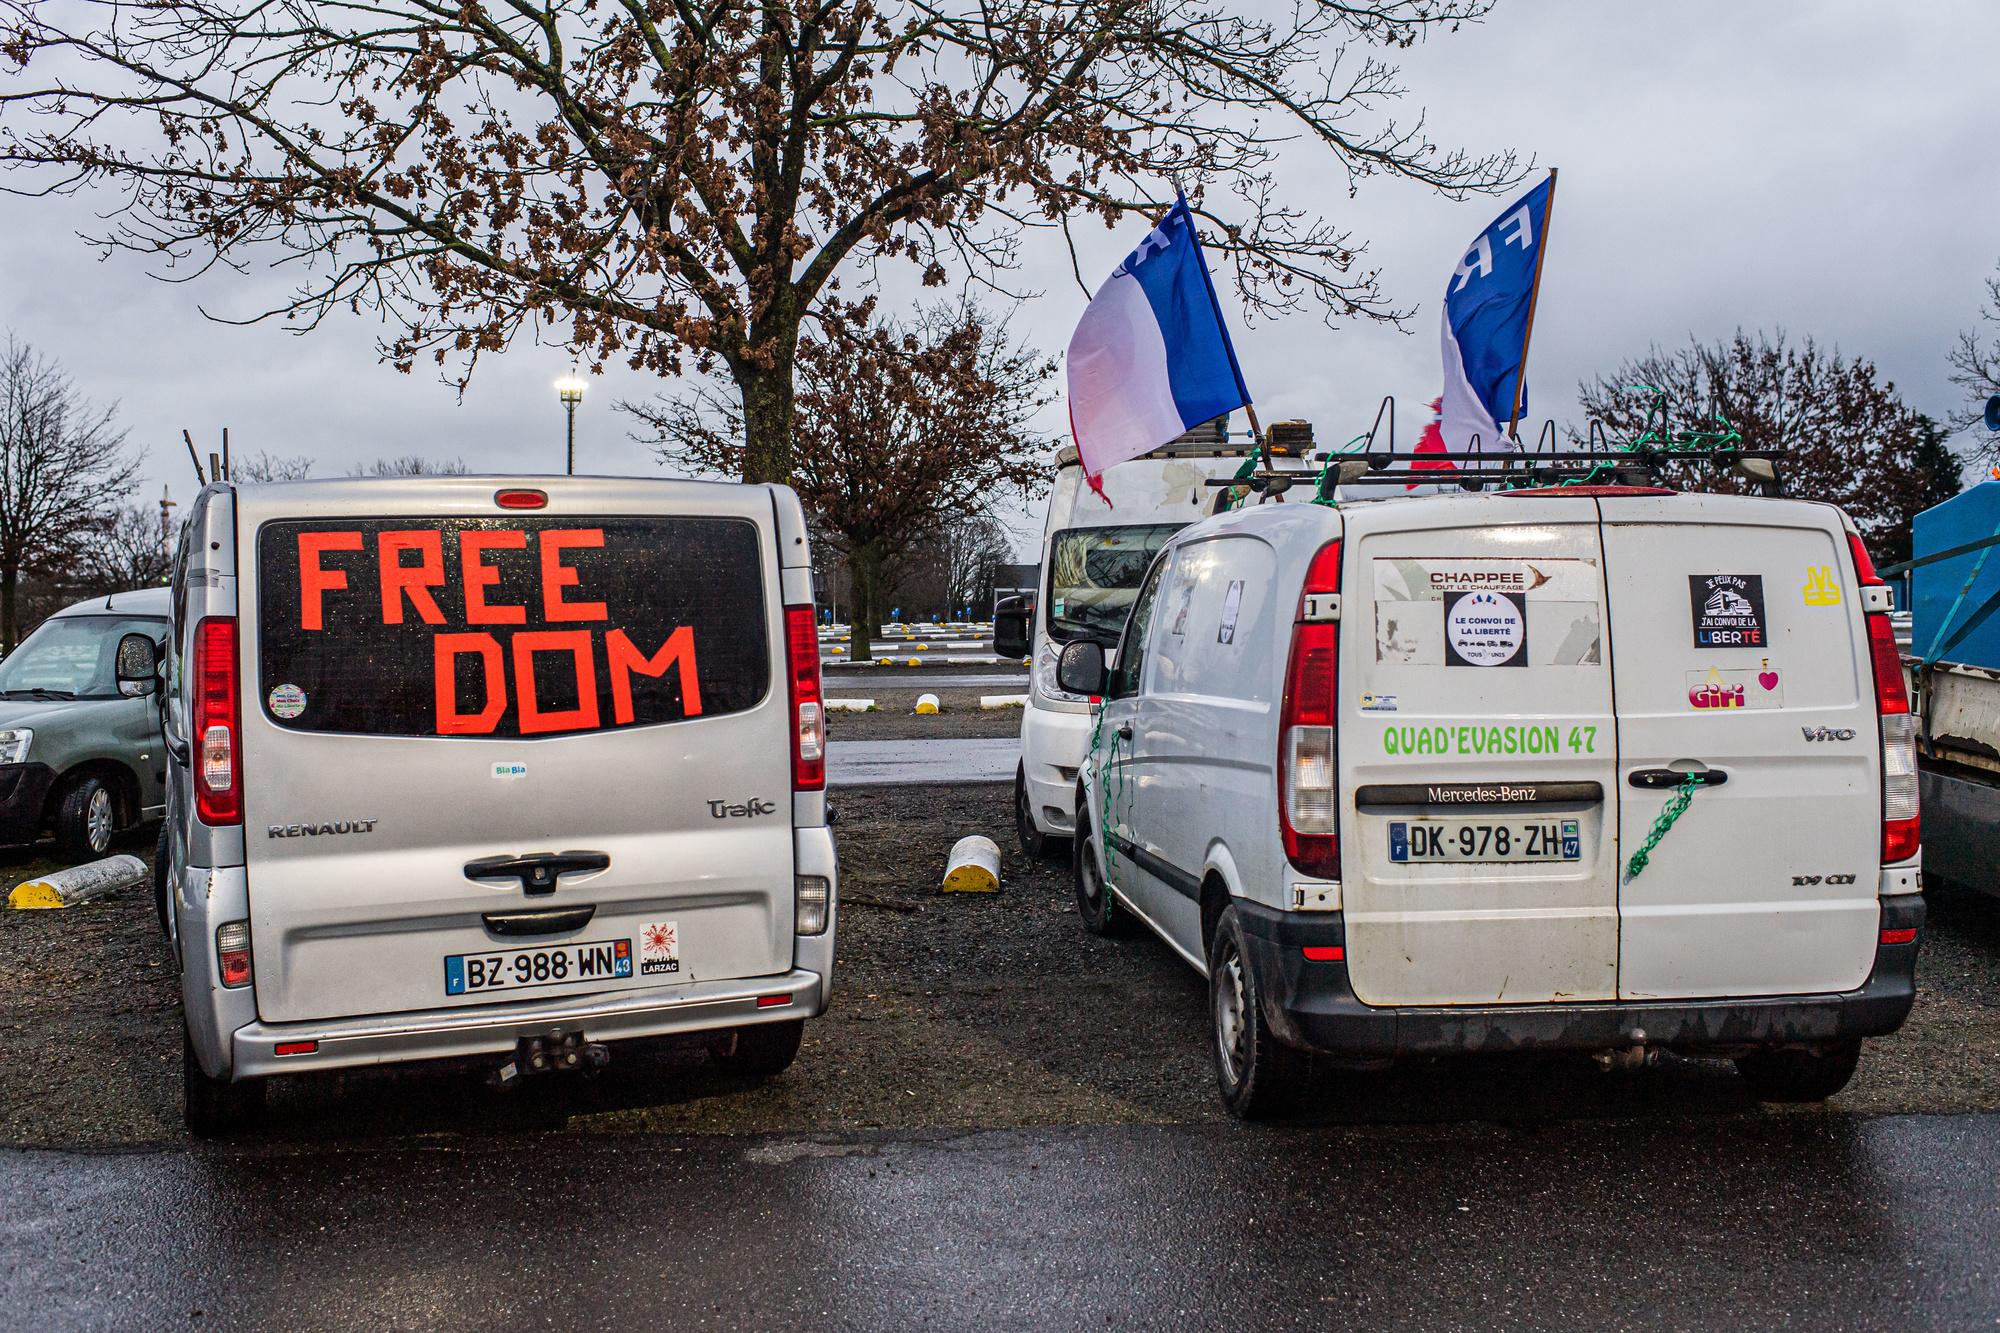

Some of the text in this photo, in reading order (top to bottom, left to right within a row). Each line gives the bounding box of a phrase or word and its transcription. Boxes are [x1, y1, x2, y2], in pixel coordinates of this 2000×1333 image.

[298, 529, 608, 631] FREE
[1430, 572, 1525, 584] CHAPPEE
[1705, 575, 1747, 589] JE PEUX PAS
[1455, 617, 1516, 625] LE CONVOI DE
[1714, 617, 1738, 626] CONVOI
[1737, 617, 1747, 626] DE
[1747, 617, 1757, 626] LA
[1461, 628, 1511, 636] LA LIBERTÉ
[1699, 629, 1761, 644] LIBERTÉ
[1467, 651, 1483, 659] TOUS
[434, 626, 702, 734] DOM
[1384, 726, 1598, 755] QUAD'EVASION 47
[1428, 785, 1536, 803] Mercedes-Benz
[707, 797, 776, 819] Trafic
[267, 817, 378, 839] RENAULT
[1396, 825, 1578, 857] F DK-978-ZH 47
[1824, 874, 1857, 885] CDI
[453, 977, 460, 988] F
[467, 946, 612, 989] BZ-988-WN
[643, 963, 678, 974] LARZAC
